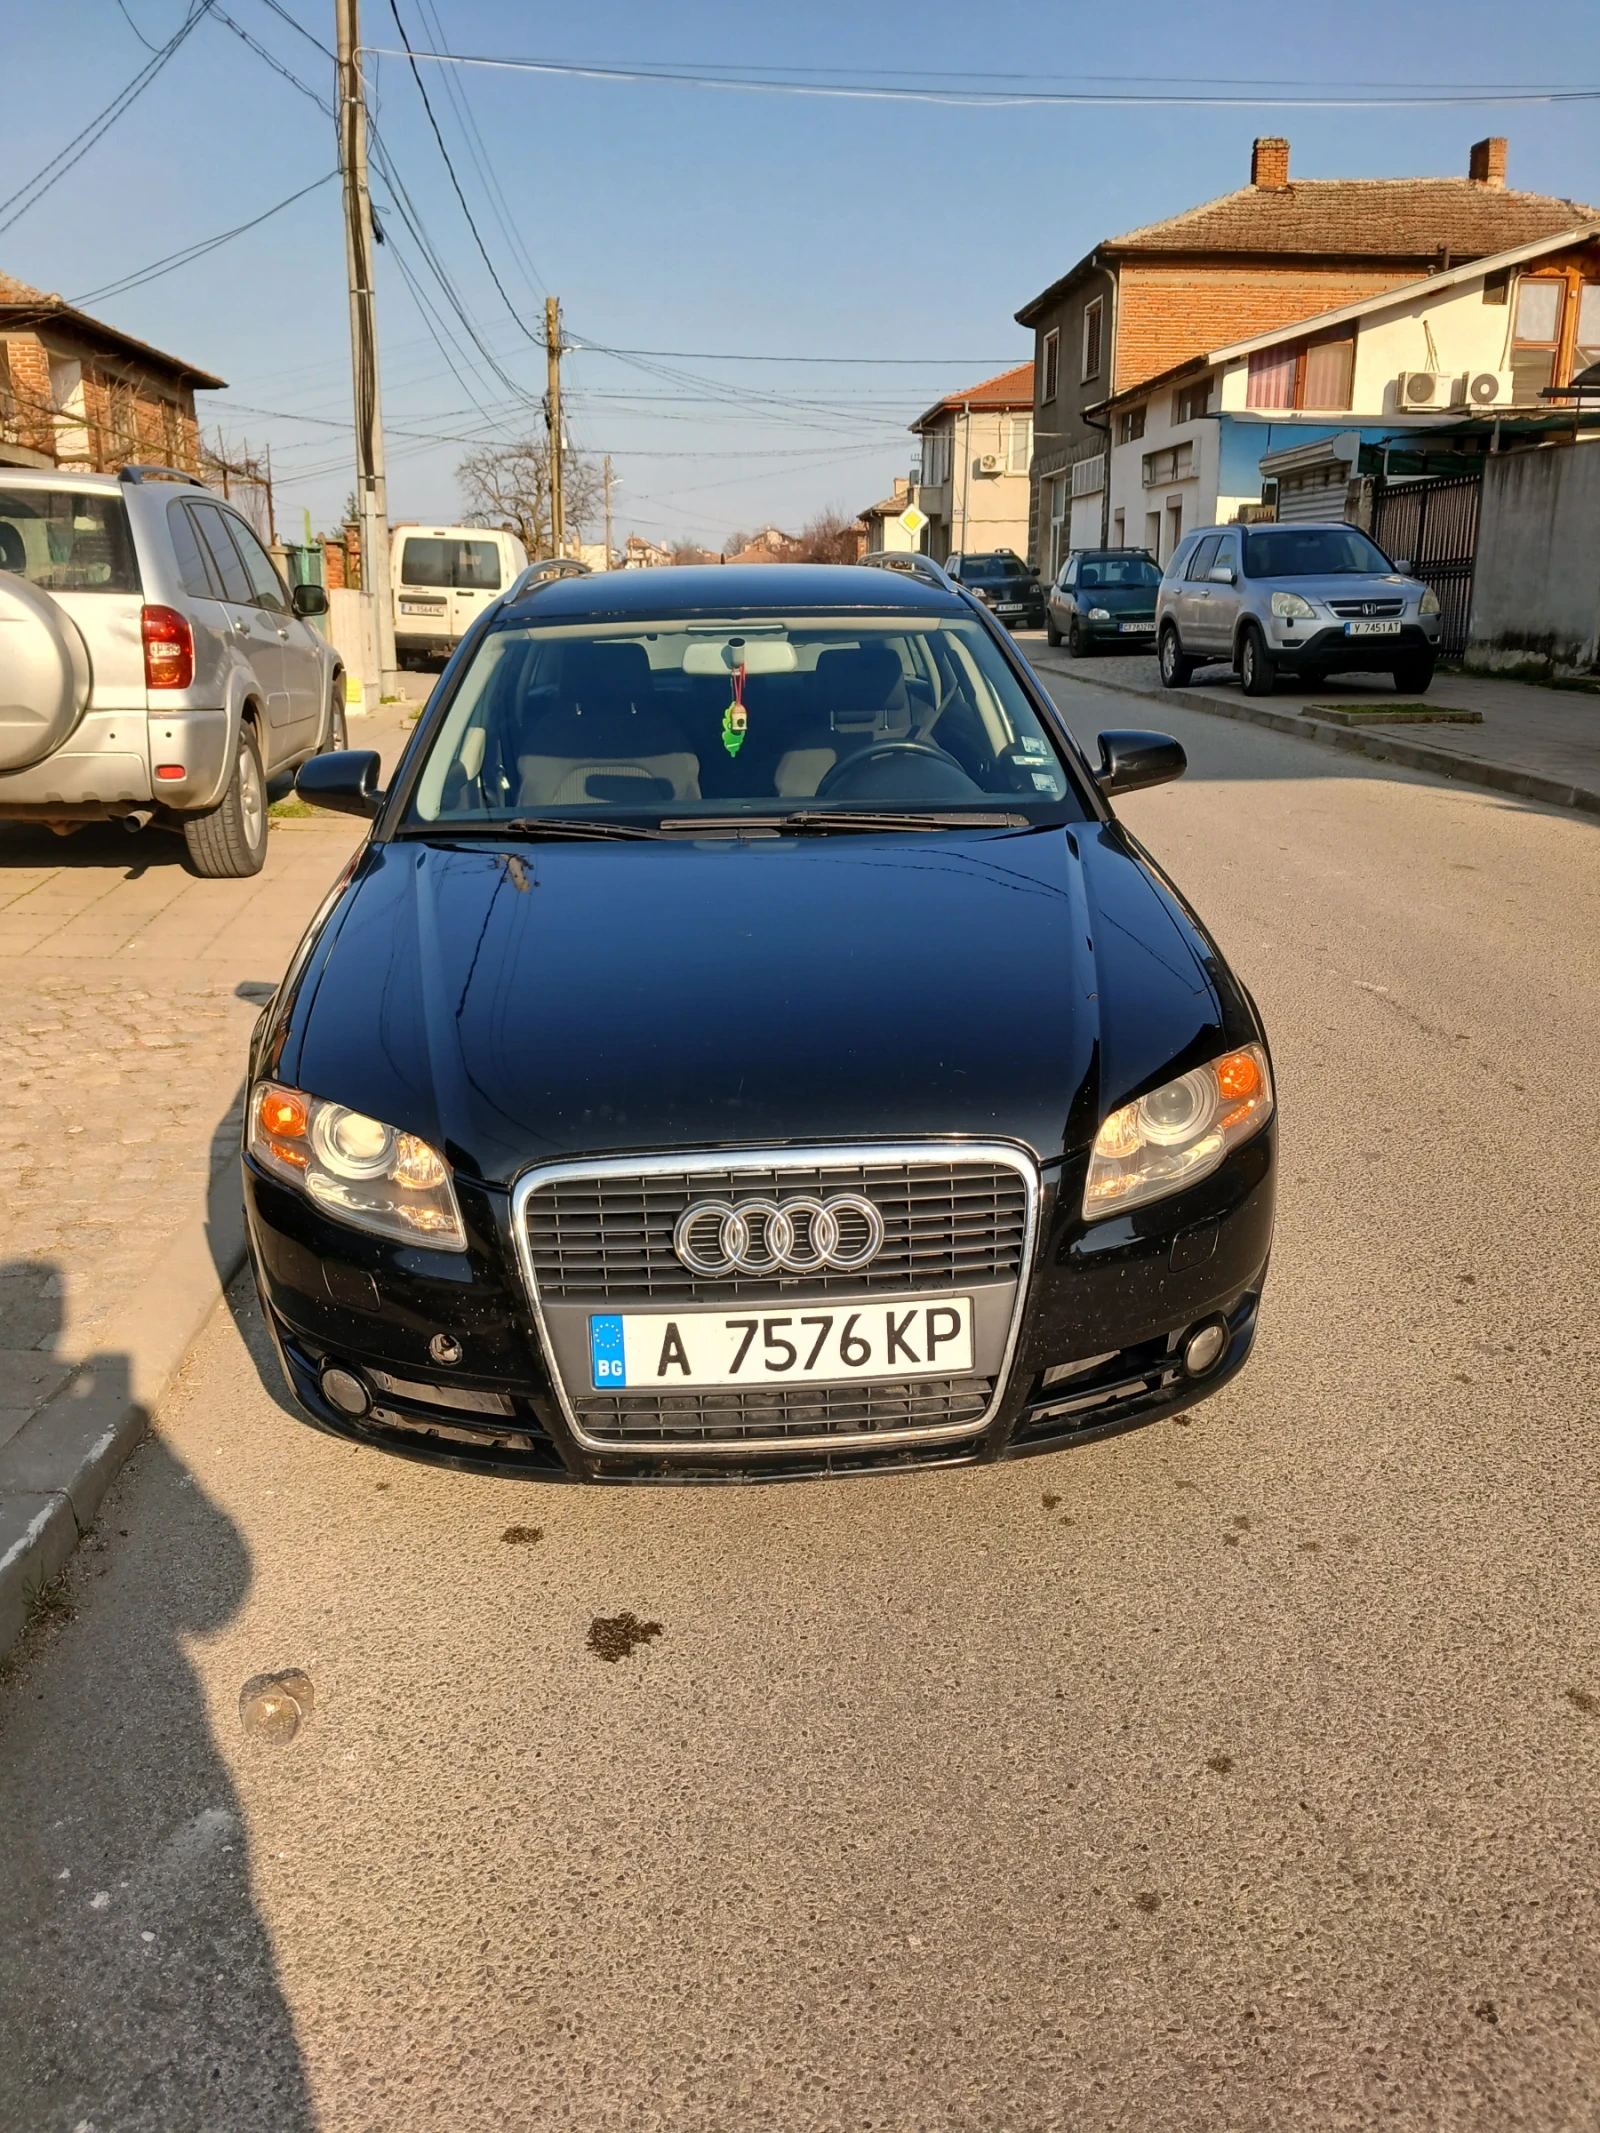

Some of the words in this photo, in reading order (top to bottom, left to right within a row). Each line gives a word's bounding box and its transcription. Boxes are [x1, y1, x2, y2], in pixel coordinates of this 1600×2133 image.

[656, 1322, 692, 1377] A
[725, 1313, 872, 1374] 7576
[598, 1359, 622, 1377] BG
